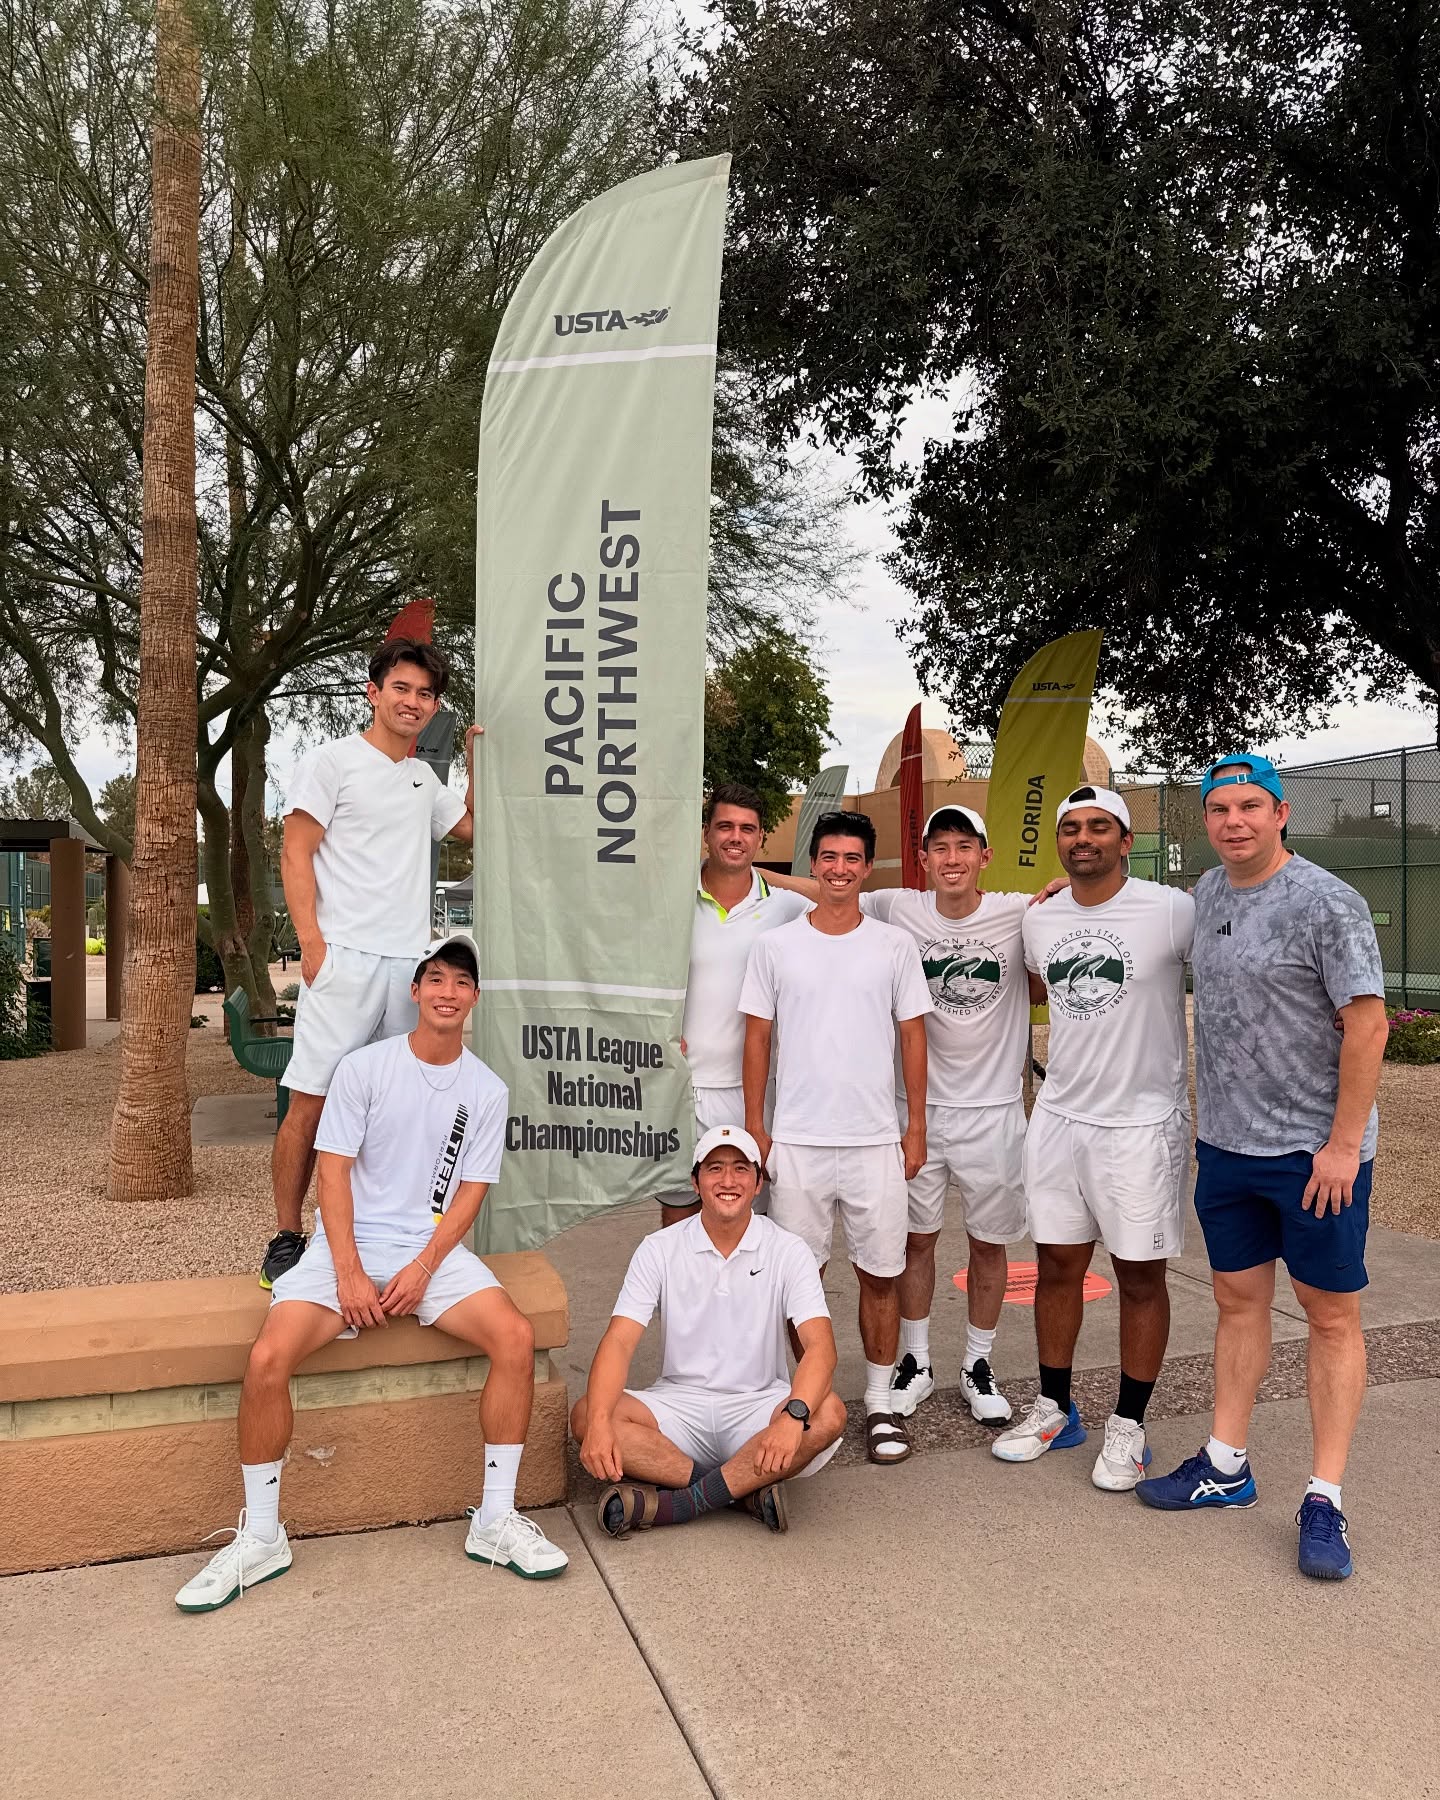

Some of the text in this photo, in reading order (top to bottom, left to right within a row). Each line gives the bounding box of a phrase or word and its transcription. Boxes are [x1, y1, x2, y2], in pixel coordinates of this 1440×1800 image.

[553, 309, 628, 337] USTA
[544, 571, 586, 796] PACIFIC
[596, 499, 641, 864] NORTHWEST
[1032, 682, 1061, 691] USTA
[1018, 774, 1046, 868] FLORIDA
[966, 938, 997, 950] STAE
[997, 952, 1008, 977] OPEN
[1096, 928, 1125, 948] STATE
[1122, 951, 1134, 980] OPEN
[933, 998, 971, 1016] BLISHED
[975, 1003, 986, 1013] IN
[1095, 1008, 1106, 1018] IN
[1110, 989, 1128, 1008] 1890
[521, 1024, 664, 1074] USTA League
[547, 1070, 643, 1111] National
[505, 1114, 681, 1162] Championships
